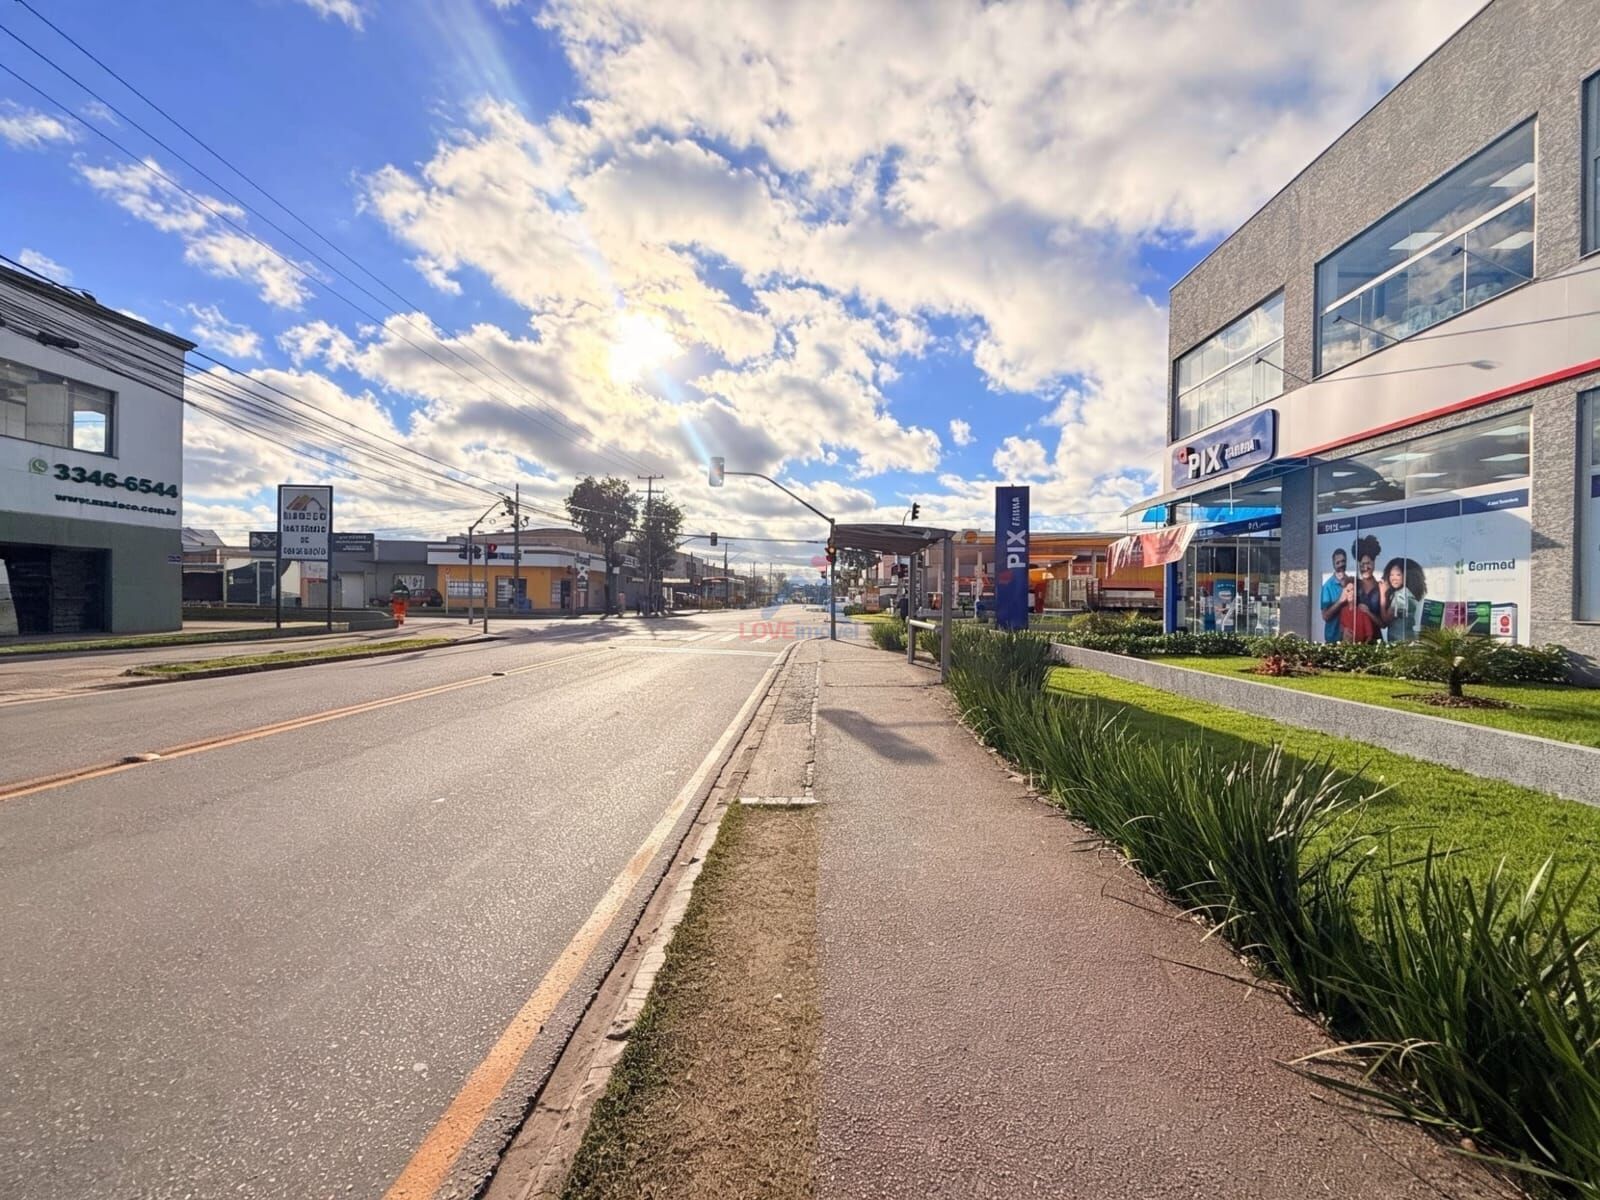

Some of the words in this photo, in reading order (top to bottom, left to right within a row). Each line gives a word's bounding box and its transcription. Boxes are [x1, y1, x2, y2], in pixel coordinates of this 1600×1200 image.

[1187, 443, 1222, 479] PIX
[53, 463, 179, 499] 3346-6544
[1006, 529, 1026, 569] PIX
